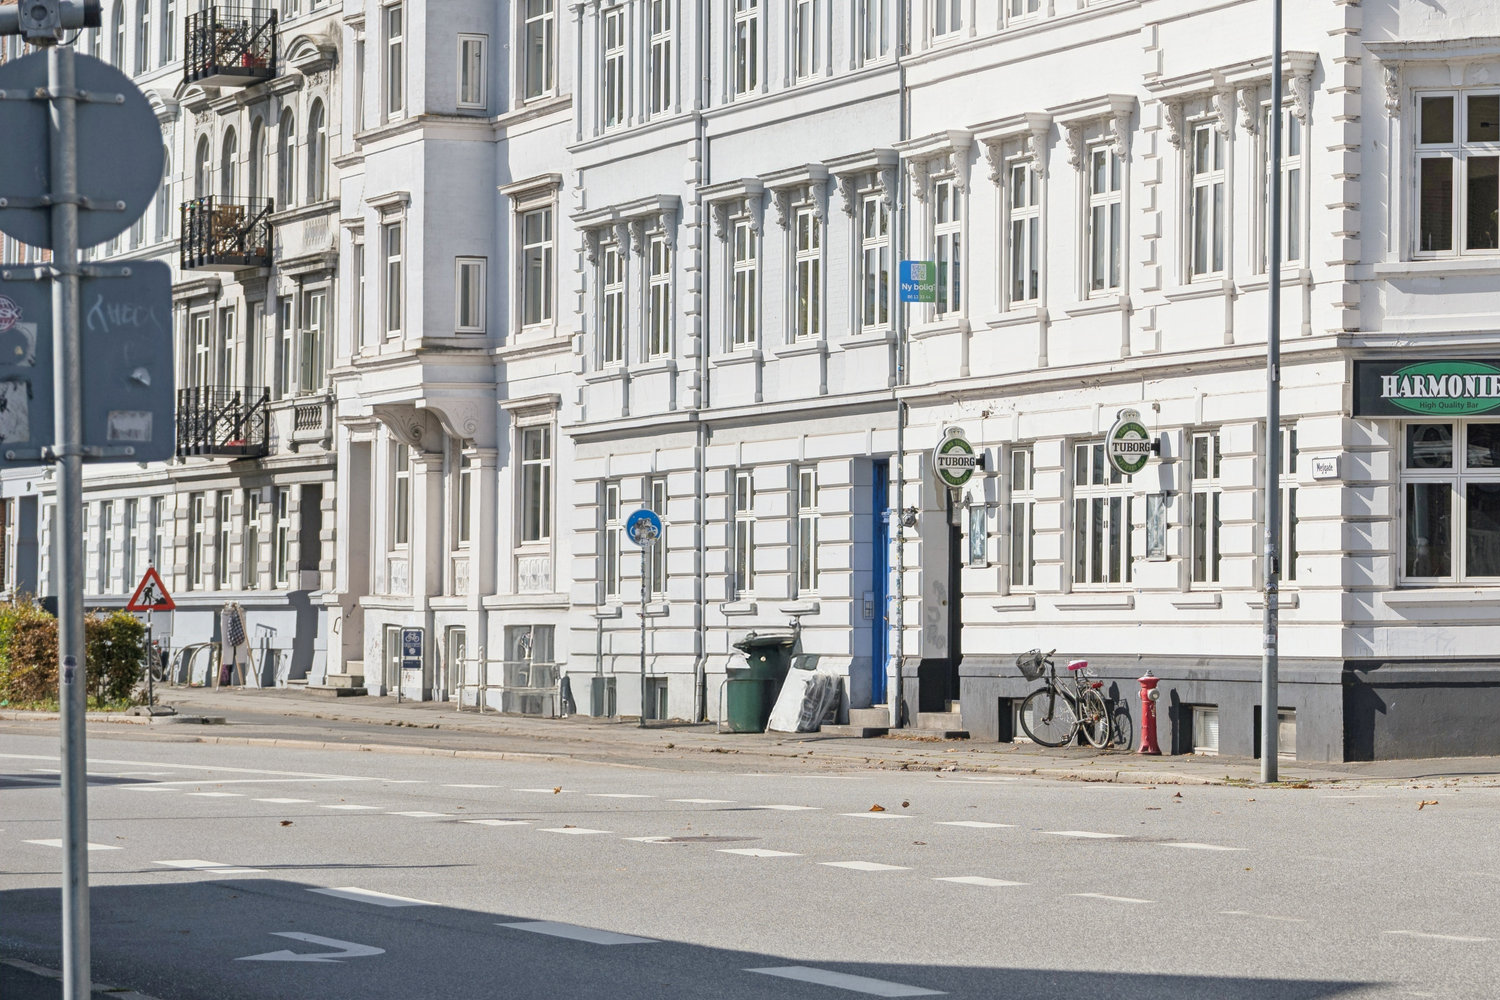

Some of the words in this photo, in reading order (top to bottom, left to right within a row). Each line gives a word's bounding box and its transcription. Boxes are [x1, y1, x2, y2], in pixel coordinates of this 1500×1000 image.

[902, 283, 912, 292] Ny
[1419, 401, 1437, 410] High
[1438, 401, 1465, 410] Quality
[1466, 401, 1479, 409] Bar
[1112, 442, 1150, 452] TUBORG
[938, 456, 975, 466] TUBORG
